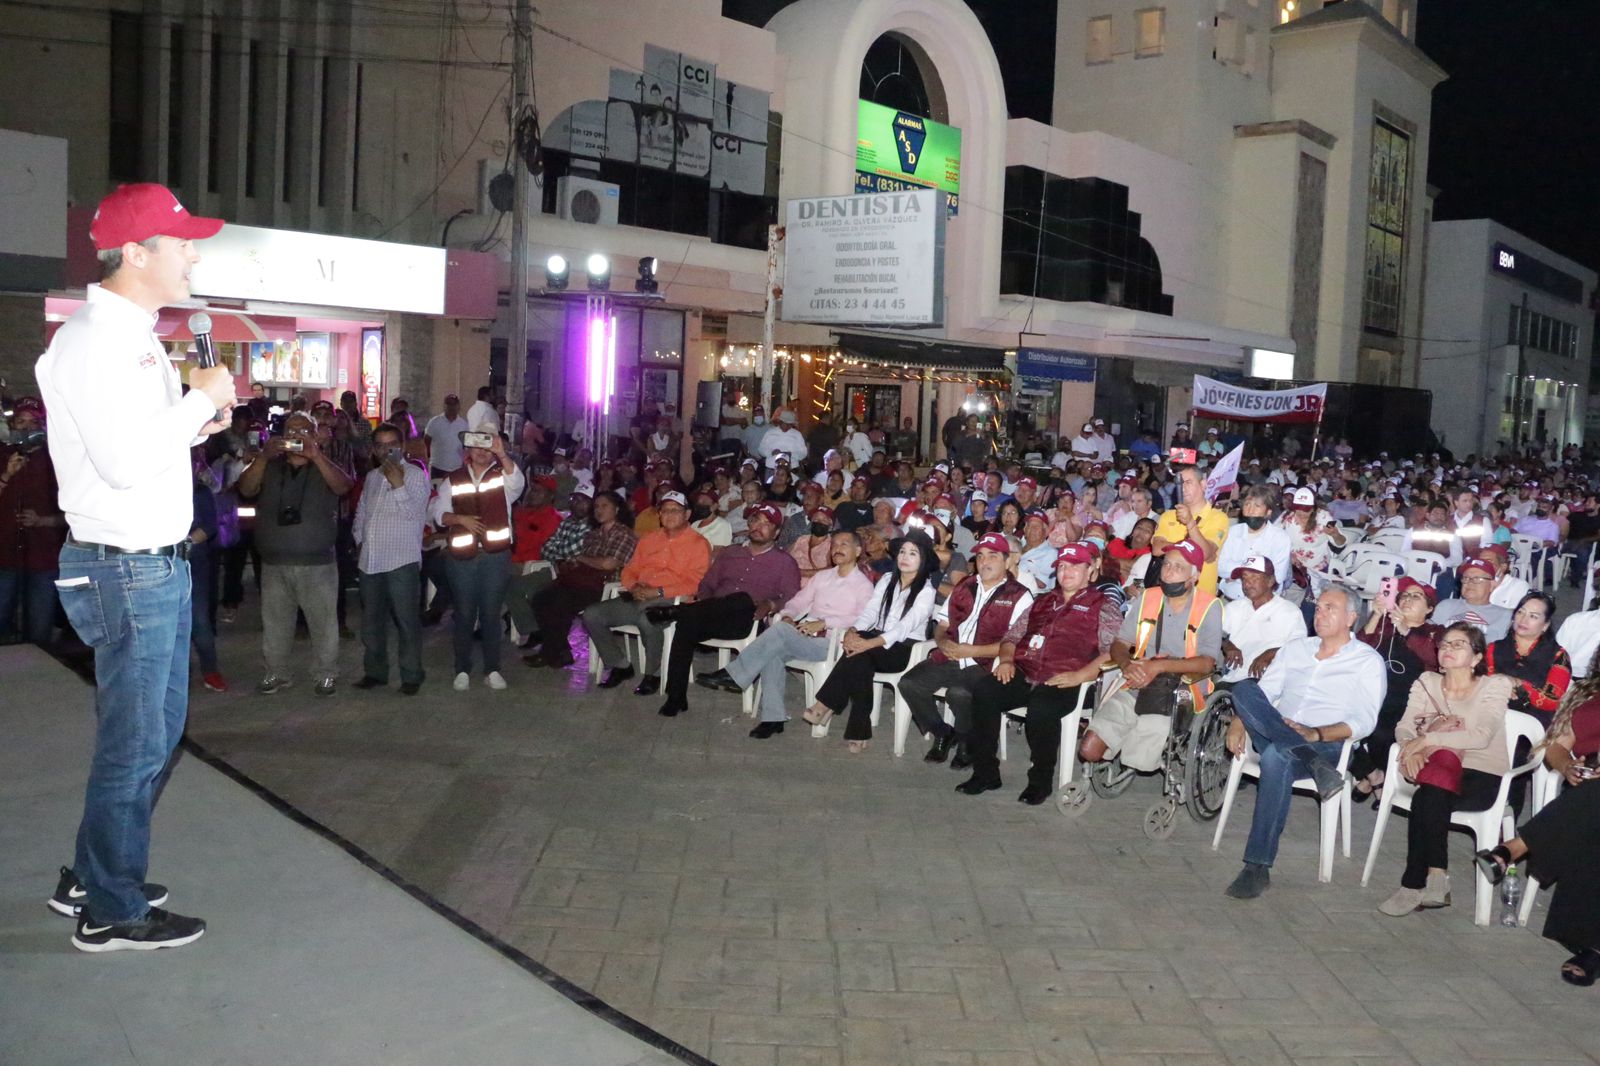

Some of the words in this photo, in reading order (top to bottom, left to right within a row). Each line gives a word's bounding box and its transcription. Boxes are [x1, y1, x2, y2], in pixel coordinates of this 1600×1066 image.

[683, 65, 709, 84] CCI
[898, 117, 922, 130] ALARMAS
[712, 134, 742, 155] CCI
[855, 174, 874, 188] Tel.
[877, 177, 904, 193] (831)
[799, 194, 921, 219] DENTISTA
[815, 219, 843, 227] RAMIRO
[853, 217, 881, 226] OLVERA
[835, 258, 871, 267] ENDODONCIA
[872, 258, 877, 266] Y
[877, 257, 900, 266] POSTES
[1499, 250, 1515, 269] BBVA
[878, 274, 897, 283] BUCAL
[809, 299, 841, 310] CITAS:
[844, 299, 858, 309] 23
[861, 299, 868, 309] 4
[872, 299, 887, 309] 44
[891, 299, 906, 309] 45
[1028, 352, 1059, 363] Distribuidor
[1200, 386, 1262, 410] JÓVENES
[1263, 395, 1292, 411] CON
[1294, 394, 1321, 412] JR
